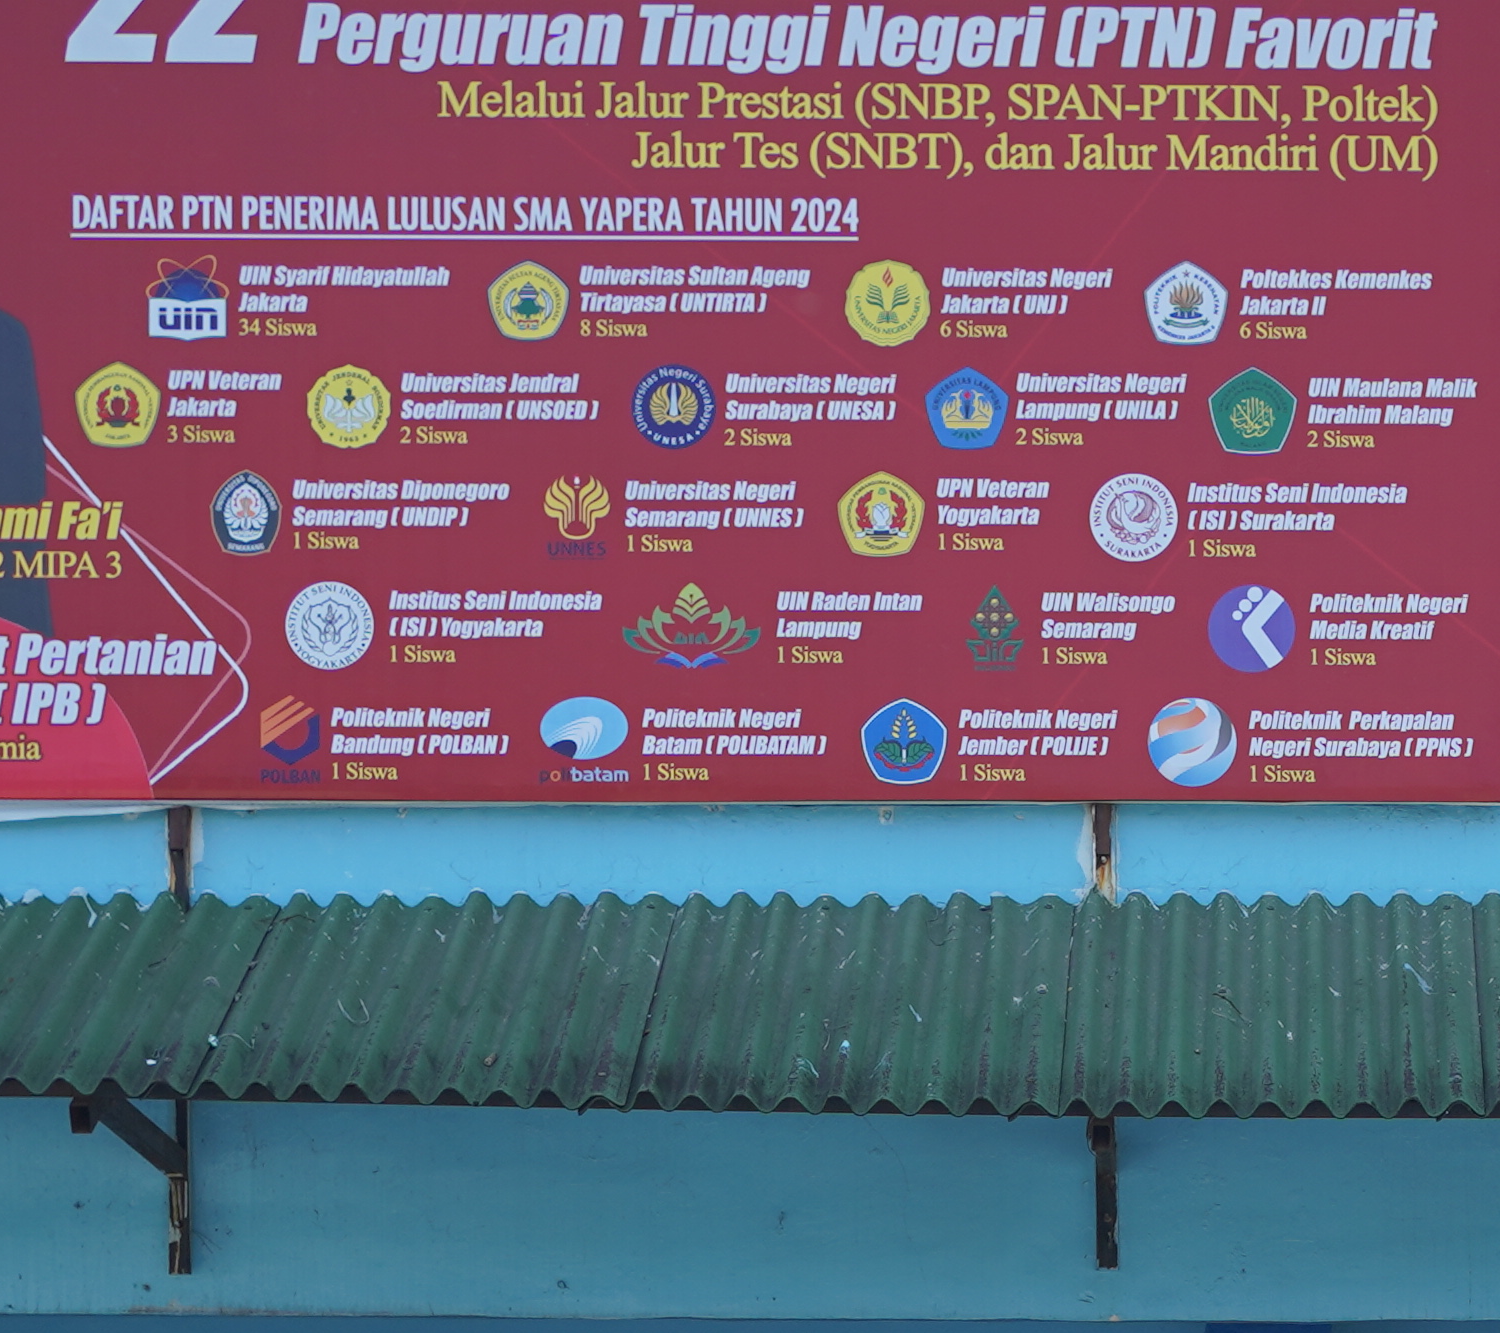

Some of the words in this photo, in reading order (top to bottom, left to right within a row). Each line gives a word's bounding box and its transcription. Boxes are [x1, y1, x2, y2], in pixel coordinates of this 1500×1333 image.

[297, 2, 624, 73] Perguruan
[639, 3, 832, 75] Tinggi
[837, 4, 1047, 75] Negeri
[1054, 6, 1217, 69] (PTN)
[1224, 7, 1439, 70] Favorit
[437, 79, 586, 119] Melalui
[594, 80, 690, 119] Jalur
[697, 81, 845, 120] Prestasi
[854, 81, 996, 129] (SNBP,
[1007, 82, 1292, 129] SPAN-PTKIN,
[1301, 83, 1438, 132] Poltek)
[631, 130, 726, 169] Jalur
[732, 131, 799, 170] Tes
[809, 131, 974, 180] (SNBT),
[984, 131, 1056, 171] dan
[1063, 132, 1159, 171] Jalur
[1165, 133, 1320, 172] Mandiri
[1329, 129, 1439, 182] (UM)
[72, 194, 175, 230] DAFTAR
[181, 195, 233, 230] PTN
[241, 195, 380, 231] PENERIMA
[387, 196, 506, 232] LULUSAN
[513, 196, 573, 232] SMA
[579, 196, 684, 232] YAPERA
[690, 197, 783, 233] TAHUN
[790, 197, 860, 233] 2024
[238, 265, 273, 286] UIN
[273, 265, 331, 288] Syarif
[330, 265, 451, 288] Hidayatullah
[578, 265, 686, 286] Universitas
[687, 265, 749, 286] Sultan
[749, 265, 811, 289] Ageng
[1240, 268, 1333, 290] Poltekkes
[1334, 269, 1433, 290] Kemenkes
[237, 291, 309, 313] Jakarta
[580, 291, 667, 315] Tirtayasa
[1239, 295, 1310, 316] Jakarta
[1310, 295, 1327, 316] II
[238, 317, 261, 336] 34
[265, 317, 318, 337] Siswa
[167, 369, 206, 391] UPN
[208, 369, 283, 391] Veteran
[400, 372, 508, 394] Universitas
[508, 372, 580, 394] Jendral
[724, 373, 832, 394] Universitas
[833, 373, 898, 397] Negeri
[1307, 377, 1342, 398] UIN
[1342, 377, 1424, 398] Maulana
[1424, 377, 1478, 398] Malik
[166, 396, 237, 418] Jakarta
[1307, 404, 1382, 425] Ibrahim
[1383, 404, 1454, 428] Malang
[292, 479, 399, 500] Universitas
[400, 479, 510, 503] Diponegoro
[1264, 482, 1310, 504] Seni
[1310, 482, 1408, 504] Indonesia
[56, 497, 127, 541] Fa'i
[937, 504, 1041, 528] Yogyakarta
[13, 550, 100, 579] MIPA
[105, 550, 122, 579] 3
[776, 590, 810, 611] UIN
[810, 591, 871, 612] Raden
[872, 591, 923, 612] Intan
[1040, 591, 1075, 612] UIN
[1076, 592, 1176, 615] Walisongo
[1309, 593, 1405, 614] Politeknik
[1405, 593, 1469, 616] Negeri
[776, 617, 863, 641] Lampung
[1040, 618, 1138, 642] Semarang
[1309, 619, 1368, 640] Media
[1369, 620, 1436, 641] Kreatif
[13, 629, 218, 676] Pertanian
[1248, 710, 1343, 731] Politeknik
[1348, 710, 1455, 733] Perkapalan
